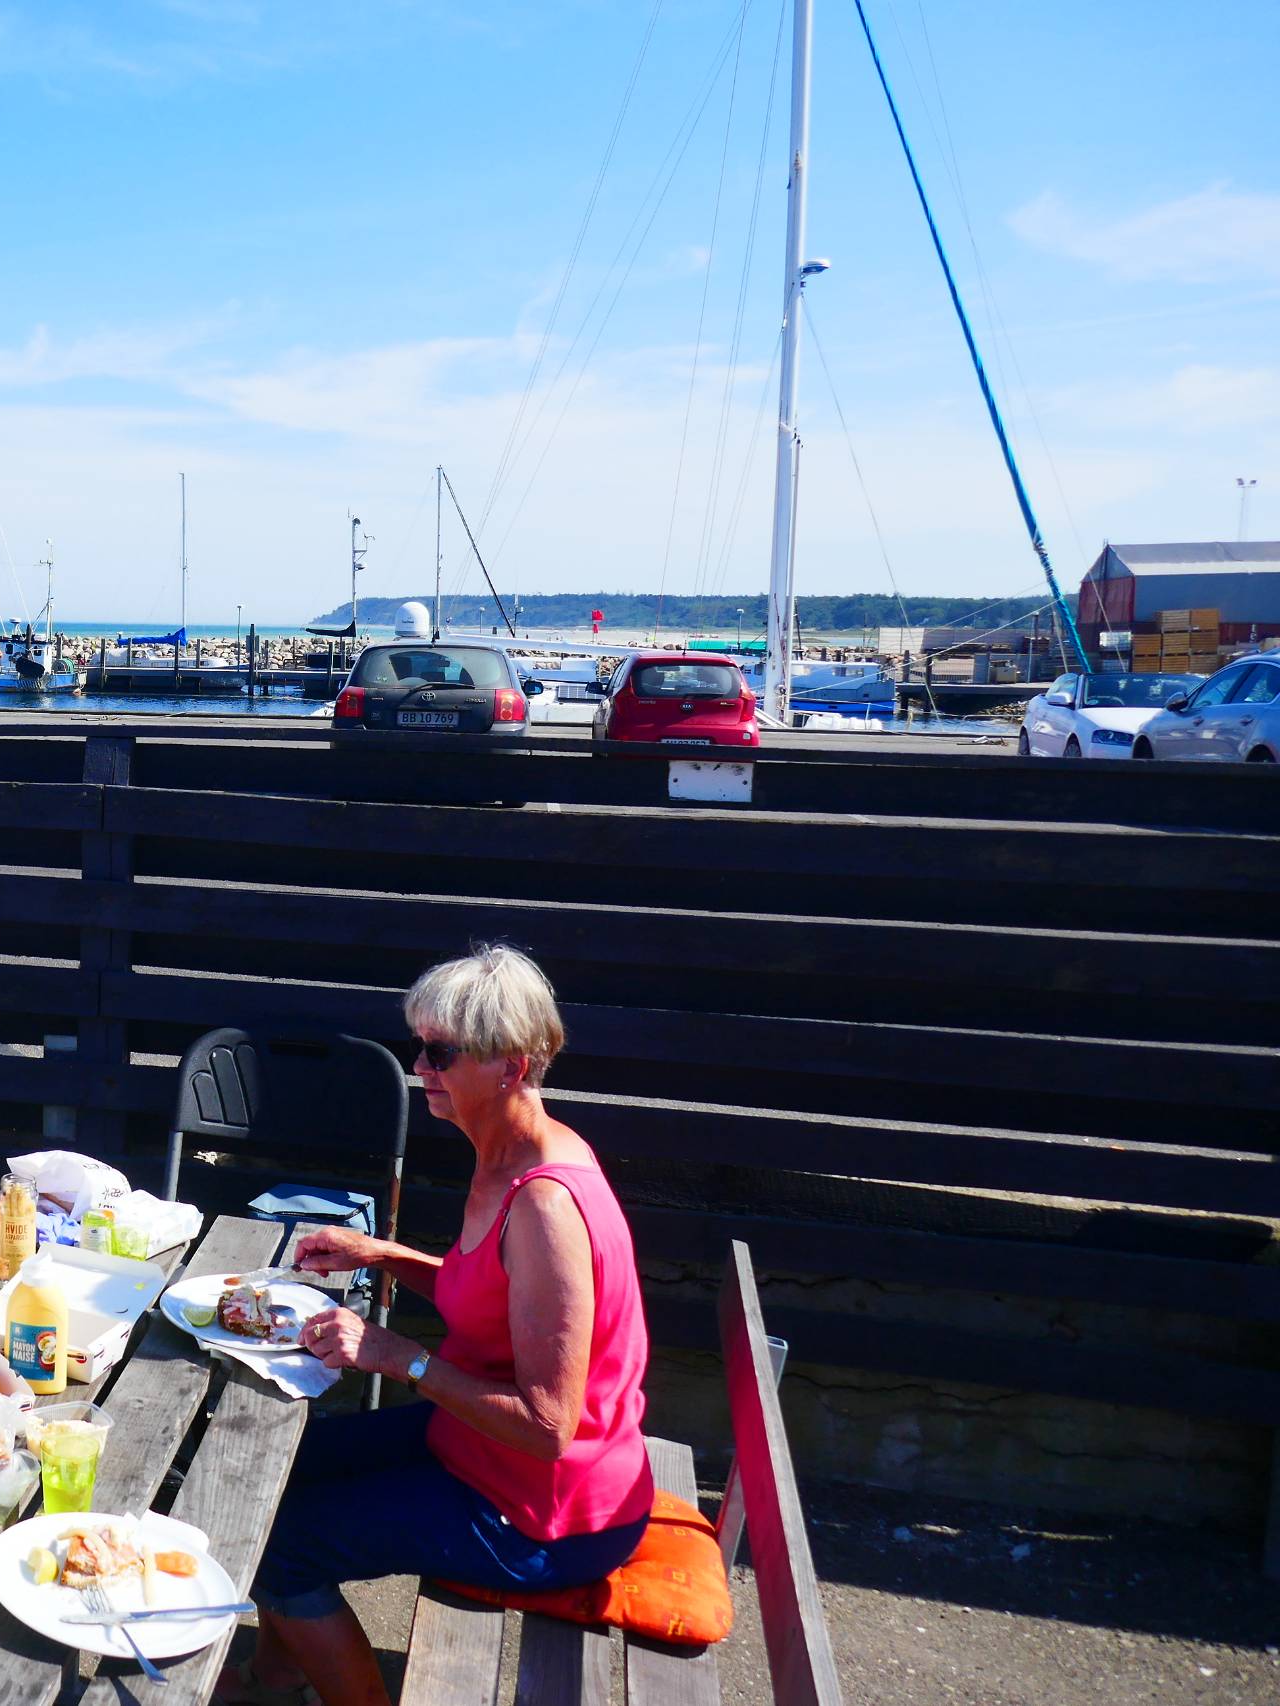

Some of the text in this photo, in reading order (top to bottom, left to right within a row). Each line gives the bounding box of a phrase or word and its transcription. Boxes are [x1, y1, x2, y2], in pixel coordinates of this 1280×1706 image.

[402, 713, 454, 723] BB 10 769
[5, 1223, 28, 1234] HVIDE
[13, 1340, 35, 1353] MAYON
[13, 1349, 35, 1363] NAISE
